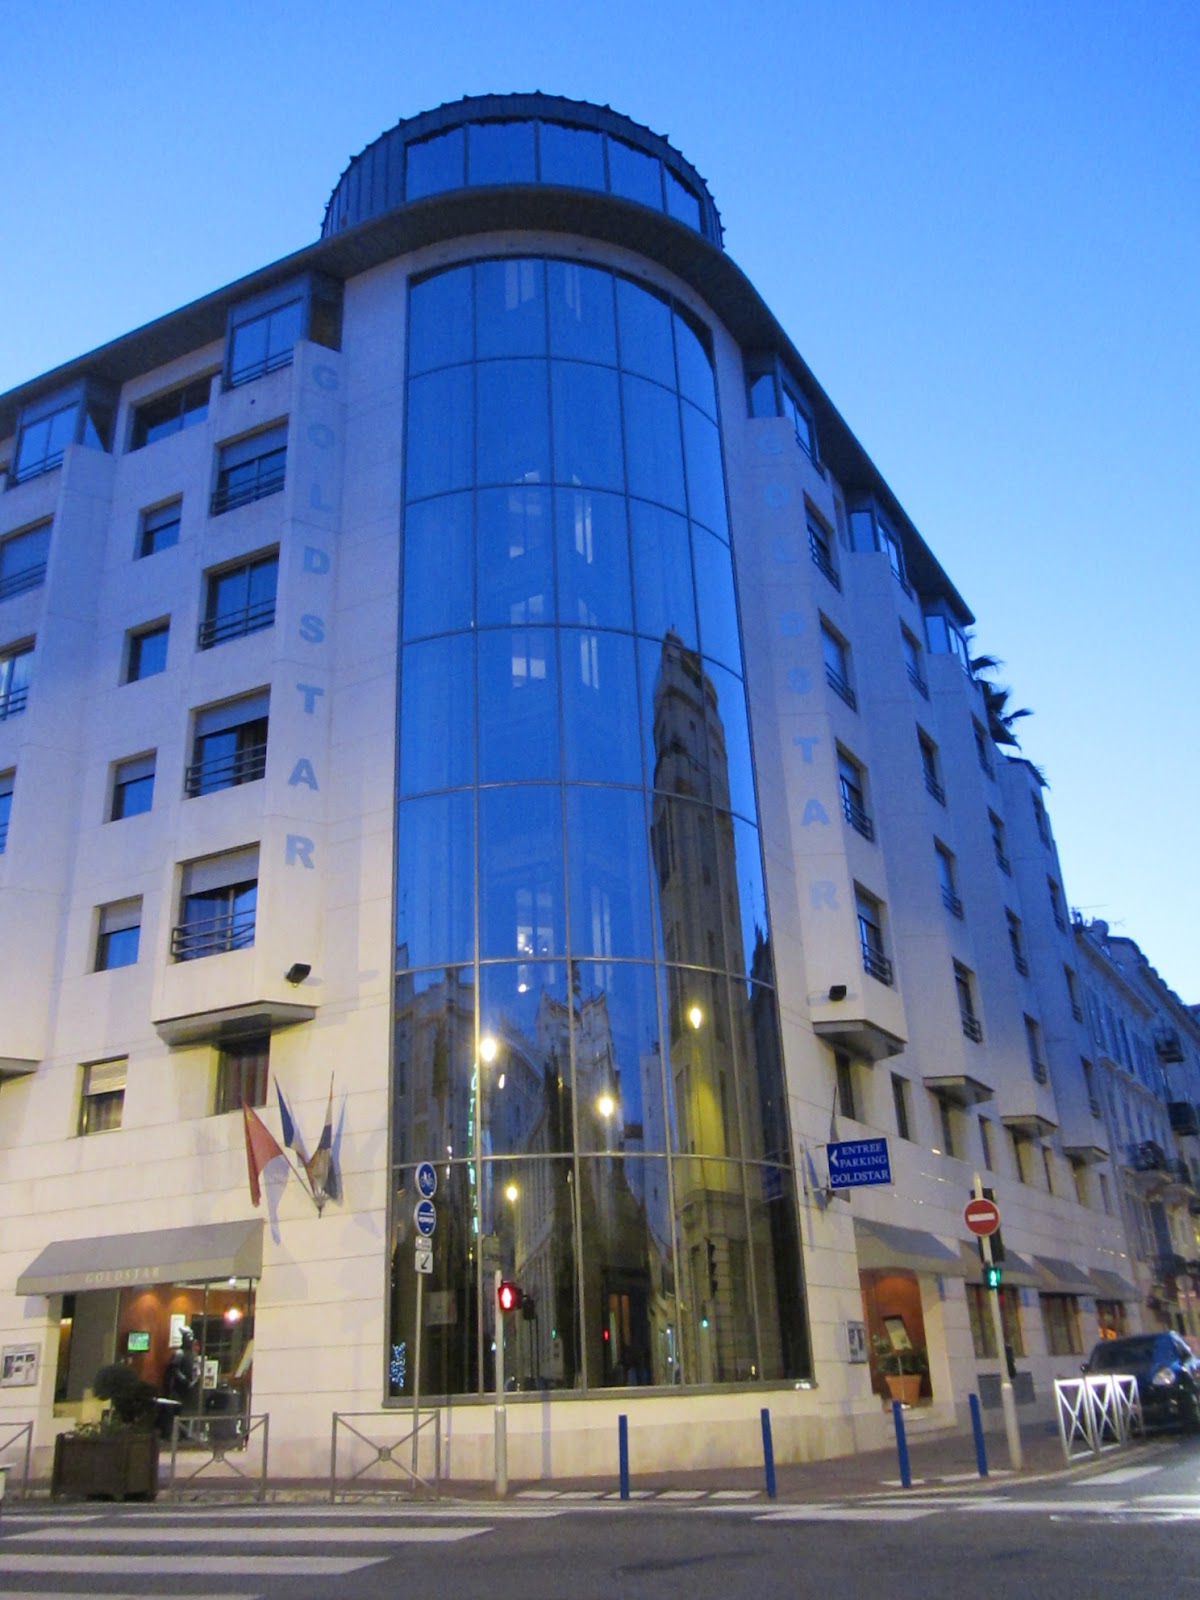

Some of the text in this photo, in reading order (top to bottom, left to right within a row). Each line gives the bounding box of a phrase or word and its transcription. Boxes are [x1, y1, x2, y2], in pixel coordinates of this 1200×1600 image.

[284, 363, 340, 870] GOLDSTAR
[754, 431, 841, 912] GOLDSTAR
[841, 1142, 883, 1155] ENTREE
[840, 1154, 887, 1168] PARKING
[831, 1169, 889, 1184] GOLDSTAR
